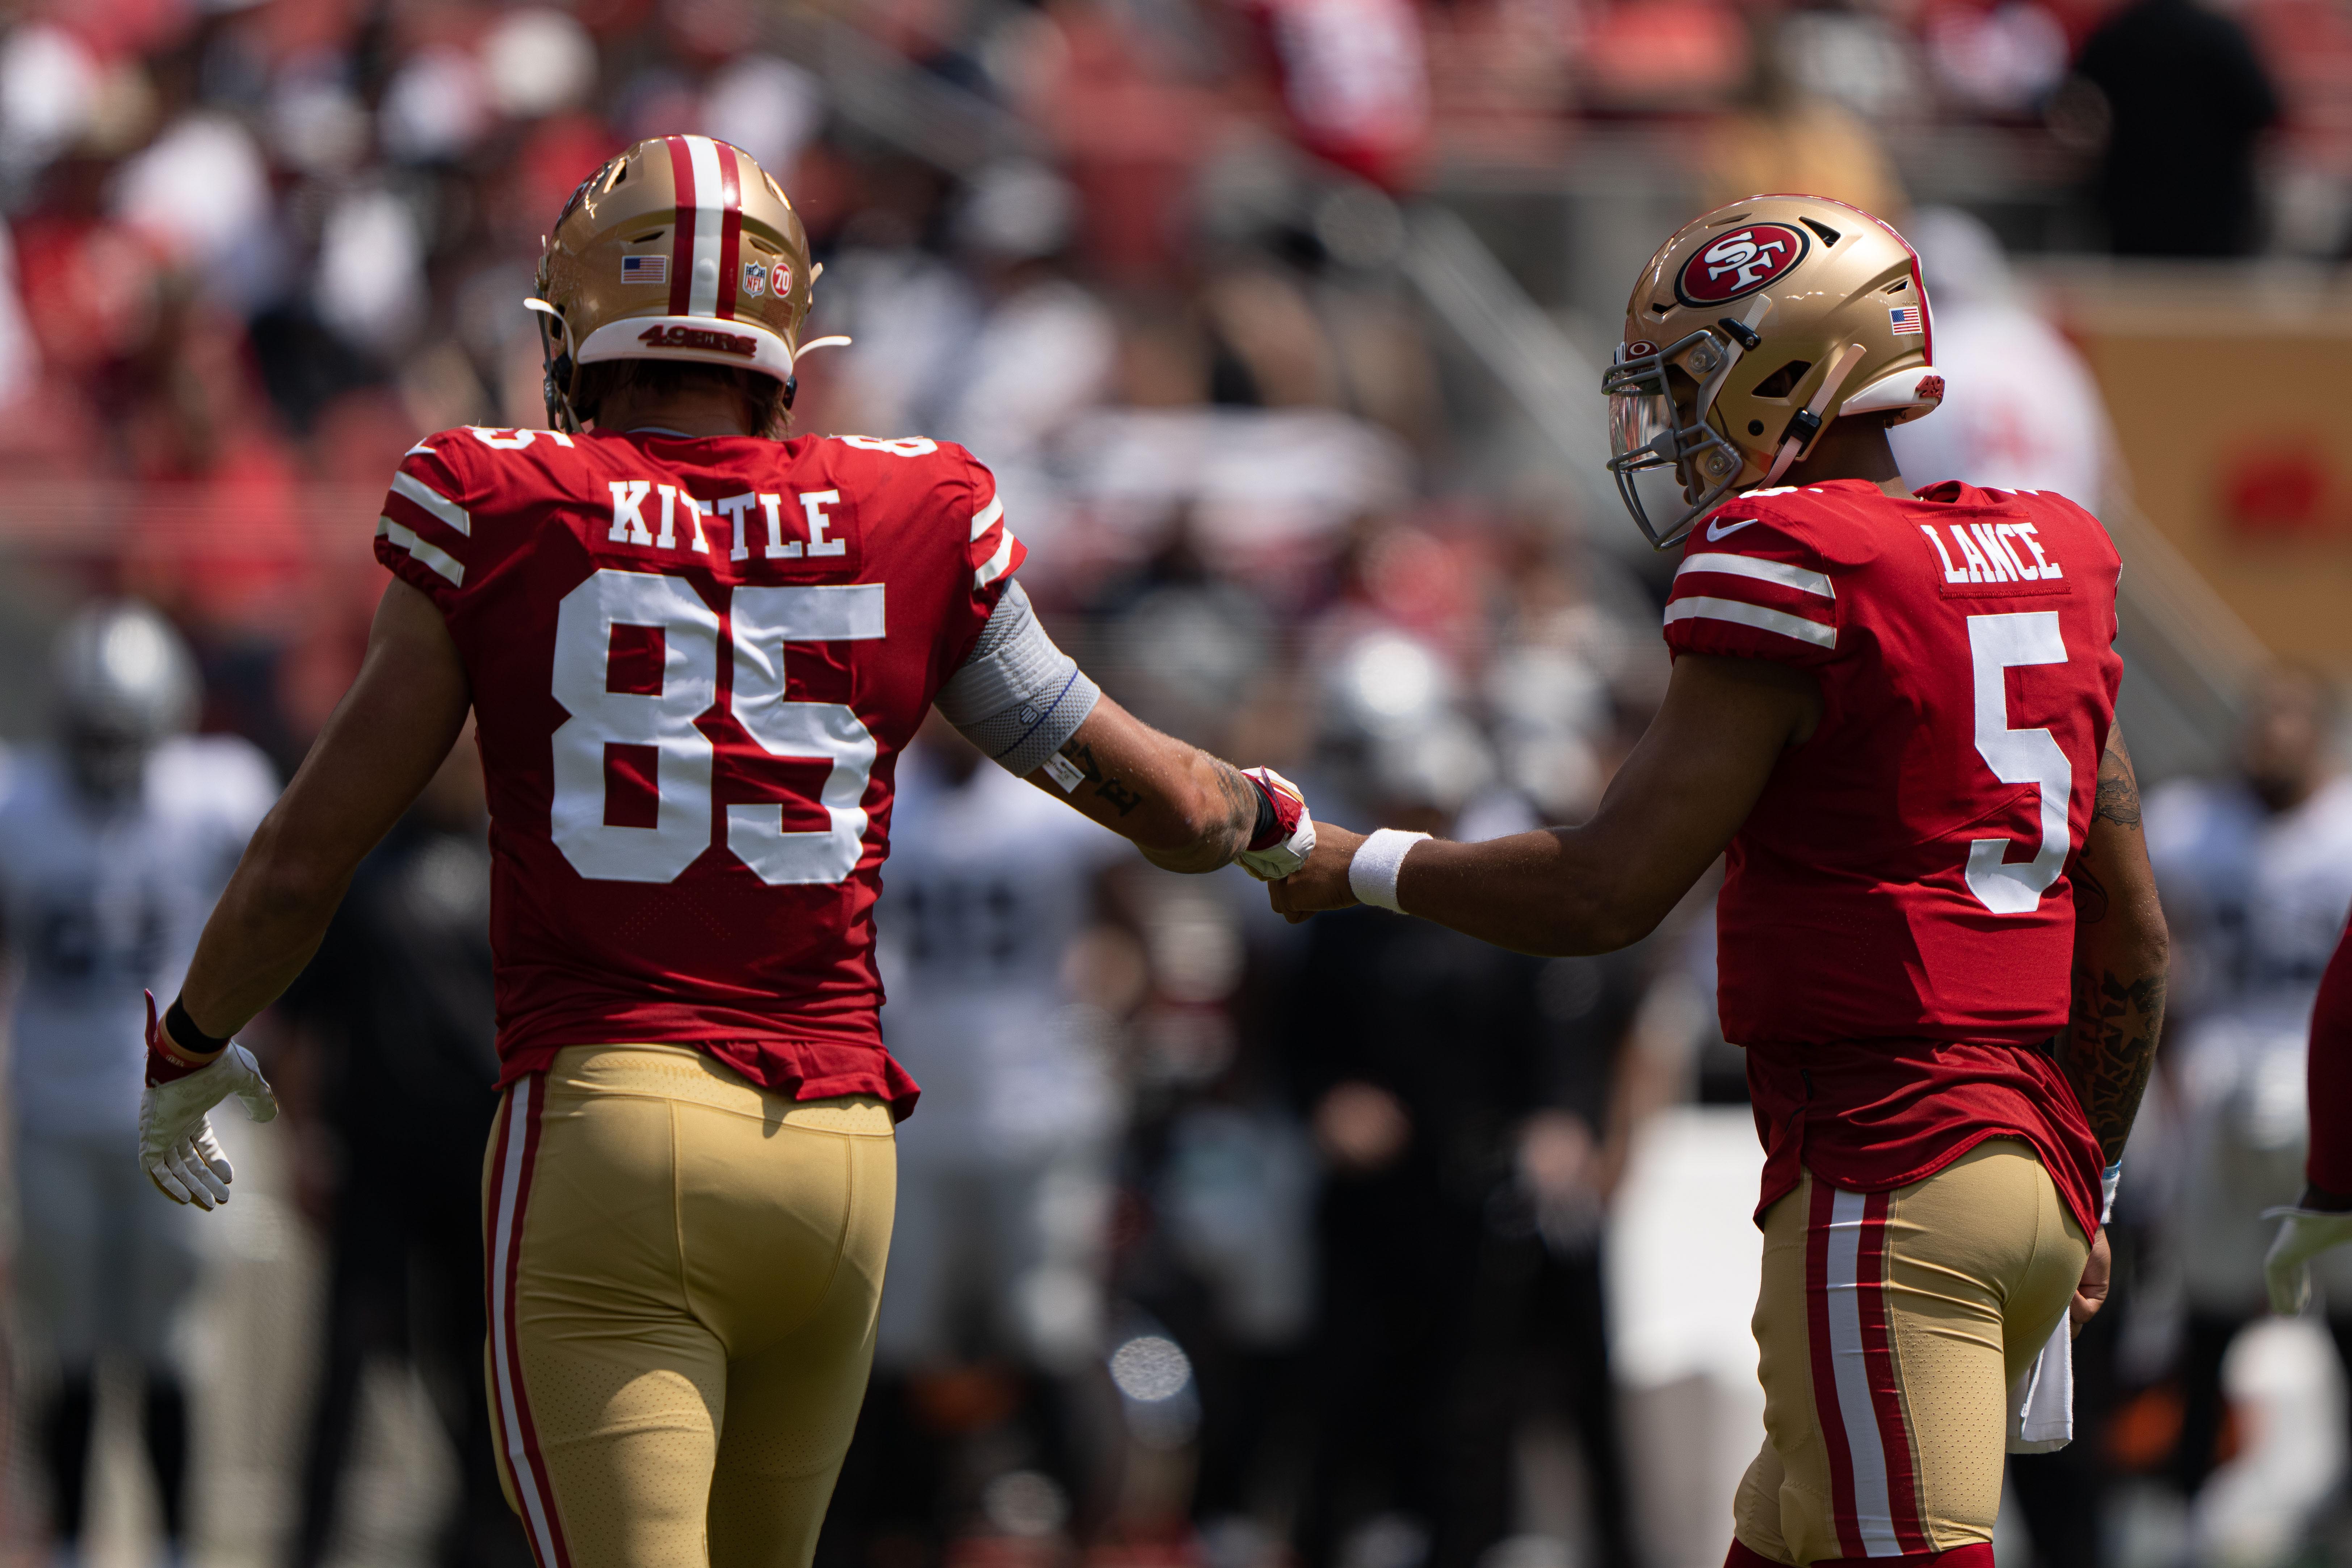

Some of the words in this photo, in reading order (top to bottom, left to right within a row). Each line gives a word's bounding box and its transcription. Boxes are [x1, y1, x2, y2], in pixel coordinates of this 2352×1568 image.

[746, 276, 763, 292] NFL
[775, 269, 790, 291] 70
[1704, 231, 1788, 292] SF
[638, 325, 757, 357] 49ERS
[608, 480, 846, 561] KITTLE
[1920, 522, 2063, 583] LANCE
[551, 568, 886, 885] 85
[1965, 611, 2072, 914] 5
